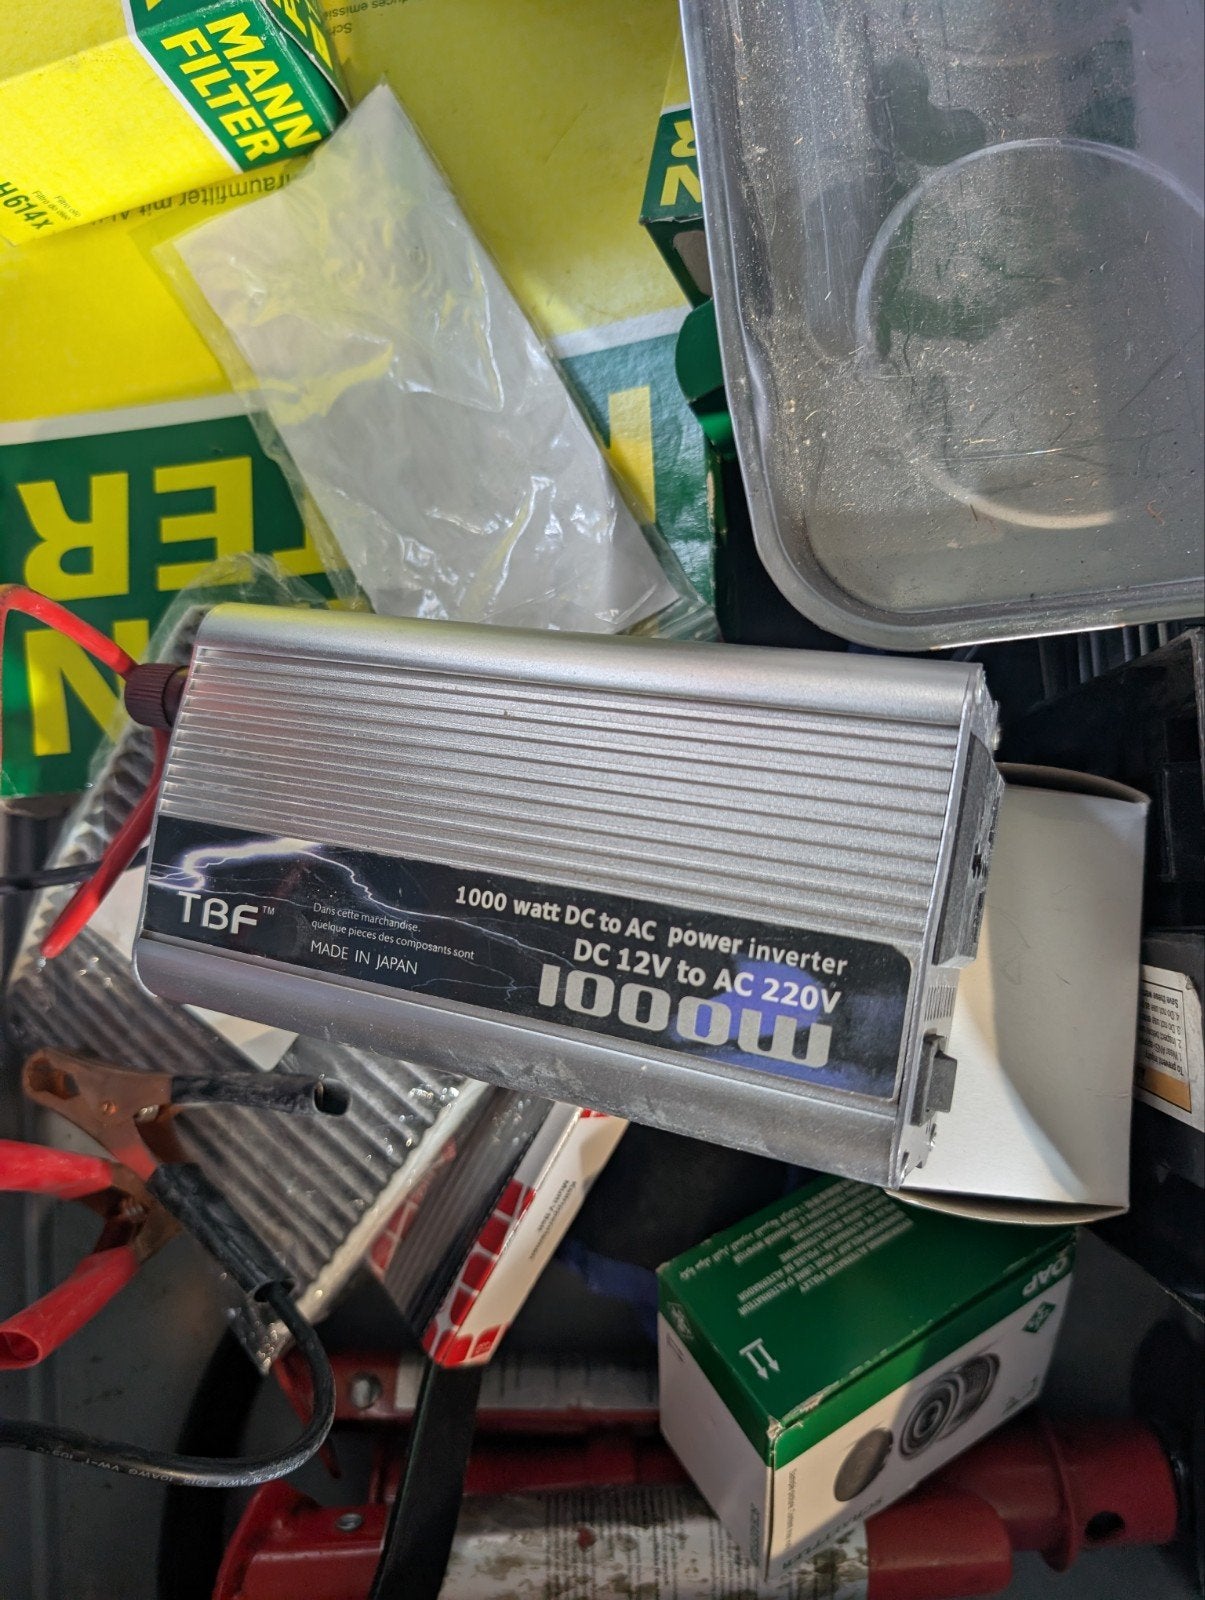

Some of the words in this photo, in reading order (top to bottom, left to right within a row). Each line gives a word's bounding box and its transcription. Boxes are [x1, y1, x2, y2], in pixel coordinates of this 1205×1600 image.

[161, 28, 280, 161] FILTER
[205, 12, 322, 148] MANN
[180, 171, 292, 208] raumfilter
[178, 890, 259, 934] TBF
[313, 902, 336, 915] Dans
[337, 906, 360, 922] cette
[361, 911, 421, 933] marchandise.
[455, 886, 507, 913] 1000
[513, 897, 562, 924] watt
[565, 905, 596, 930] DC
[599, 912, 622, 935] to
[625, 917, 656, 941] AC
[667, 925, 744, 957] power
[748, 937, 848, 977] inverter
[311, 919, 347, 937] quelque
[348, 925, 377, 942] pieces
[378, 931, 394, 945] des
[395, 936, 452, 957] composants
[453, 948, 475, 961] sont
[311, 940, 349, 961] MADE
[355, 949, 370, 965] IN
[376, 954, 419, 975] JAPAN
[573, 938, 611, 965] DC
[616, 947, 673, 977] 12V
[677, 957, 706, 988] to
[713, 969, 754, 998] AC
[759, 977, 843, 1014] 220V
